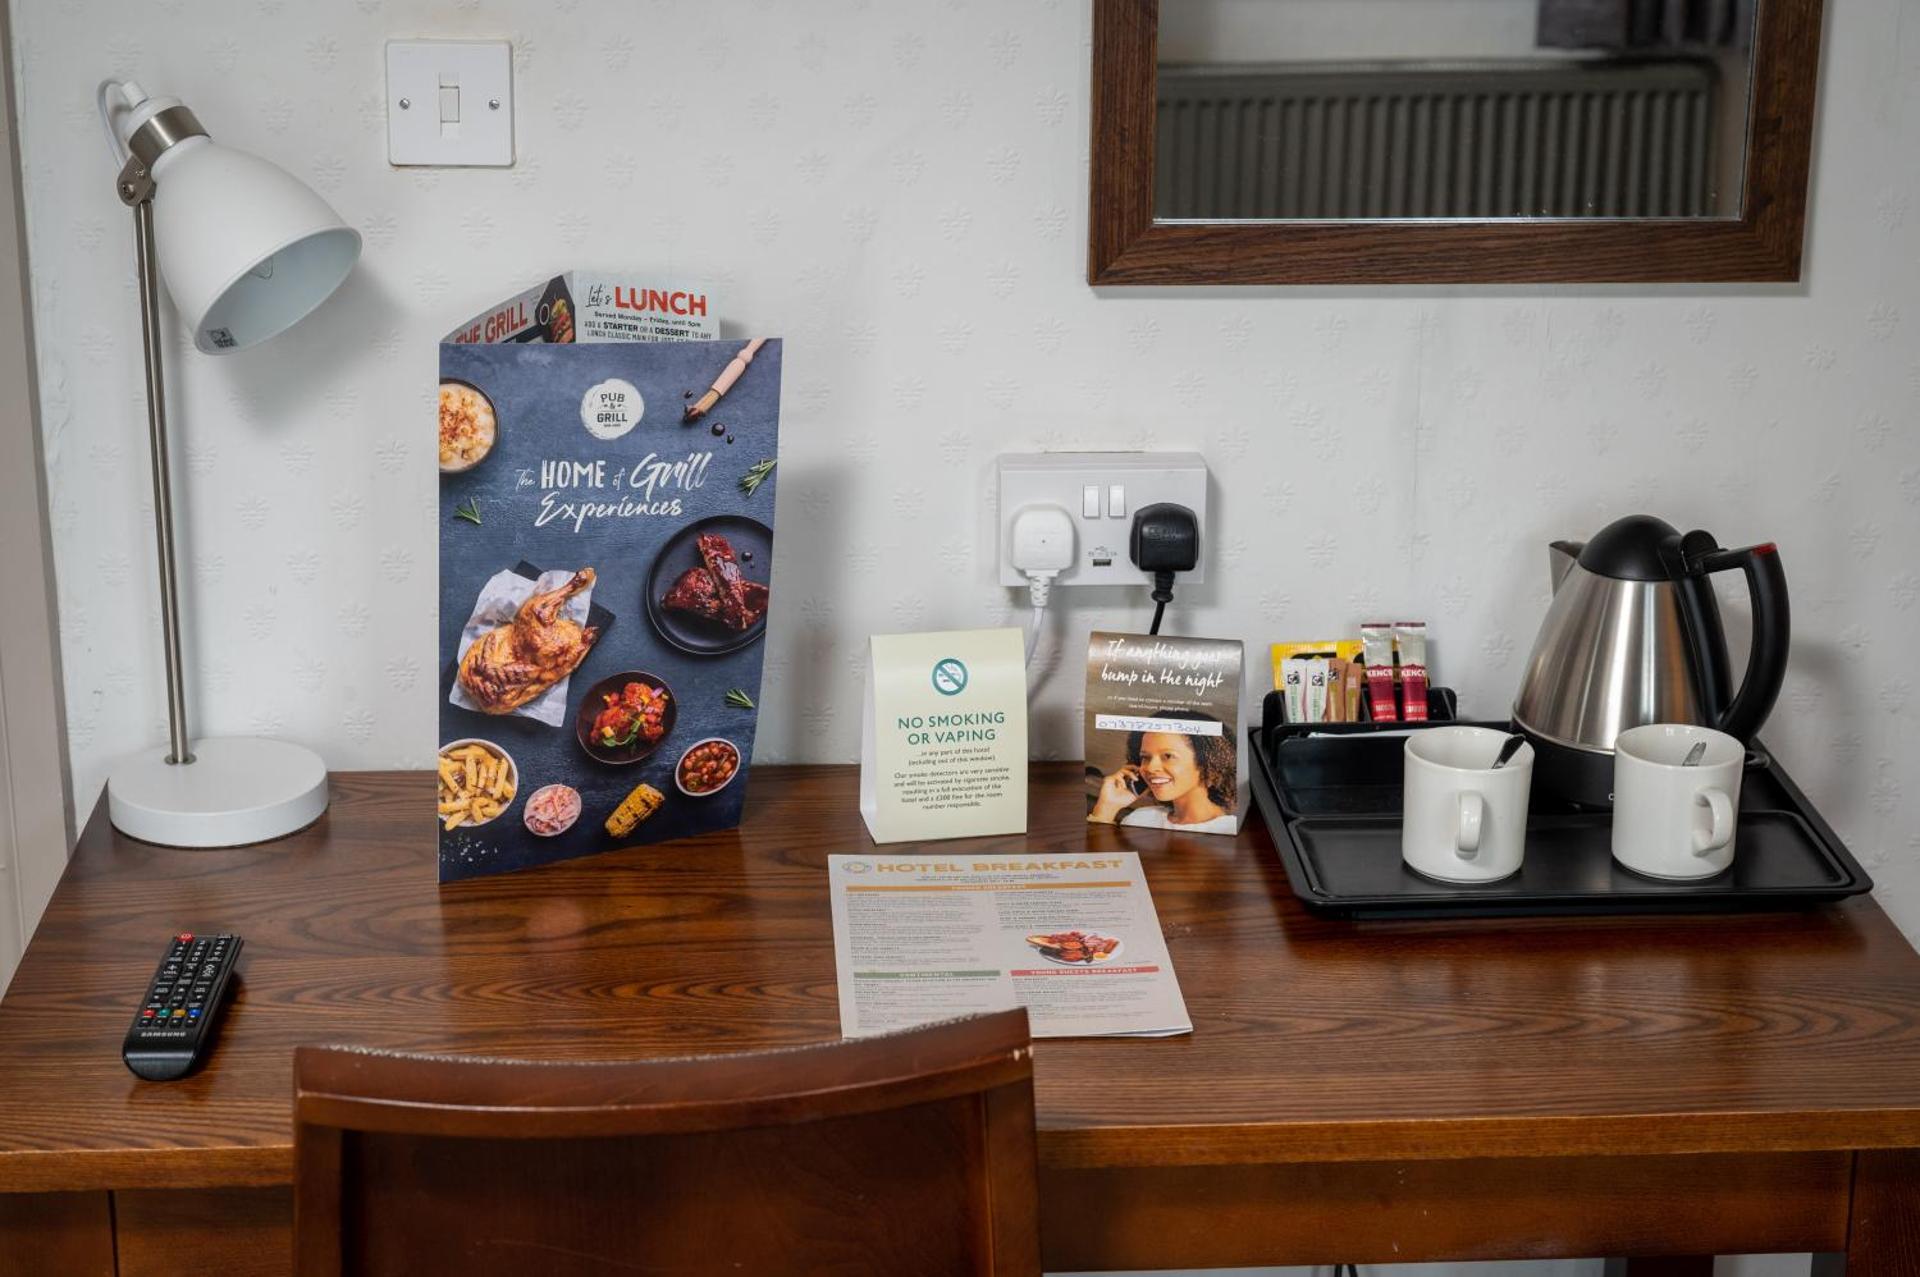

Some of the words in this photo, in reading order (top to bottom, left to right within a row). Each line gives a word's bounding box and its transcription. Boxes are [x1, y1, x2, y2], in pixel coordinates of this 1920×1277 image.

[614, 286, 707, 317] LUNCH
[485, 301, 528, 344] GRILL
[594, 311, 617, 319] Served
[617, 313, 642, 322] Monday
[687, 320, 702, 328] 5pm
[603, 321, 639, 332] STARTER
[655, 326, 690, 337] DESSERT
[607, 331, 632, 340] CLASSIC
[600, 392, 626, 403] PUB
[597, 412, 628, 423] GRILL
[515, 468, 535, 492] The
[541, 459, 606, 490] HOME
[612, 467, 626, 491] of
[629, 451, 713, 502] Grill
[534, 491, 684, 534] Experiences
[1105, 638, 1125, 662] If
[1101, 663, 1139, 687] bump
[1141, 670, 1157, 684] in
[1160, 667, 1182, 687] the
[1184, 671, 1224, 697] night
[897, 717, 924, 729] NO
[928, 711, 1005, 728] SMOKING
[907, 732, 930, 745] OR
[935, 728, 996, 744] VAPING
[877, 863, 964, 873] HOTEL
[972, 859, 1123, 872] BREAKFAST
